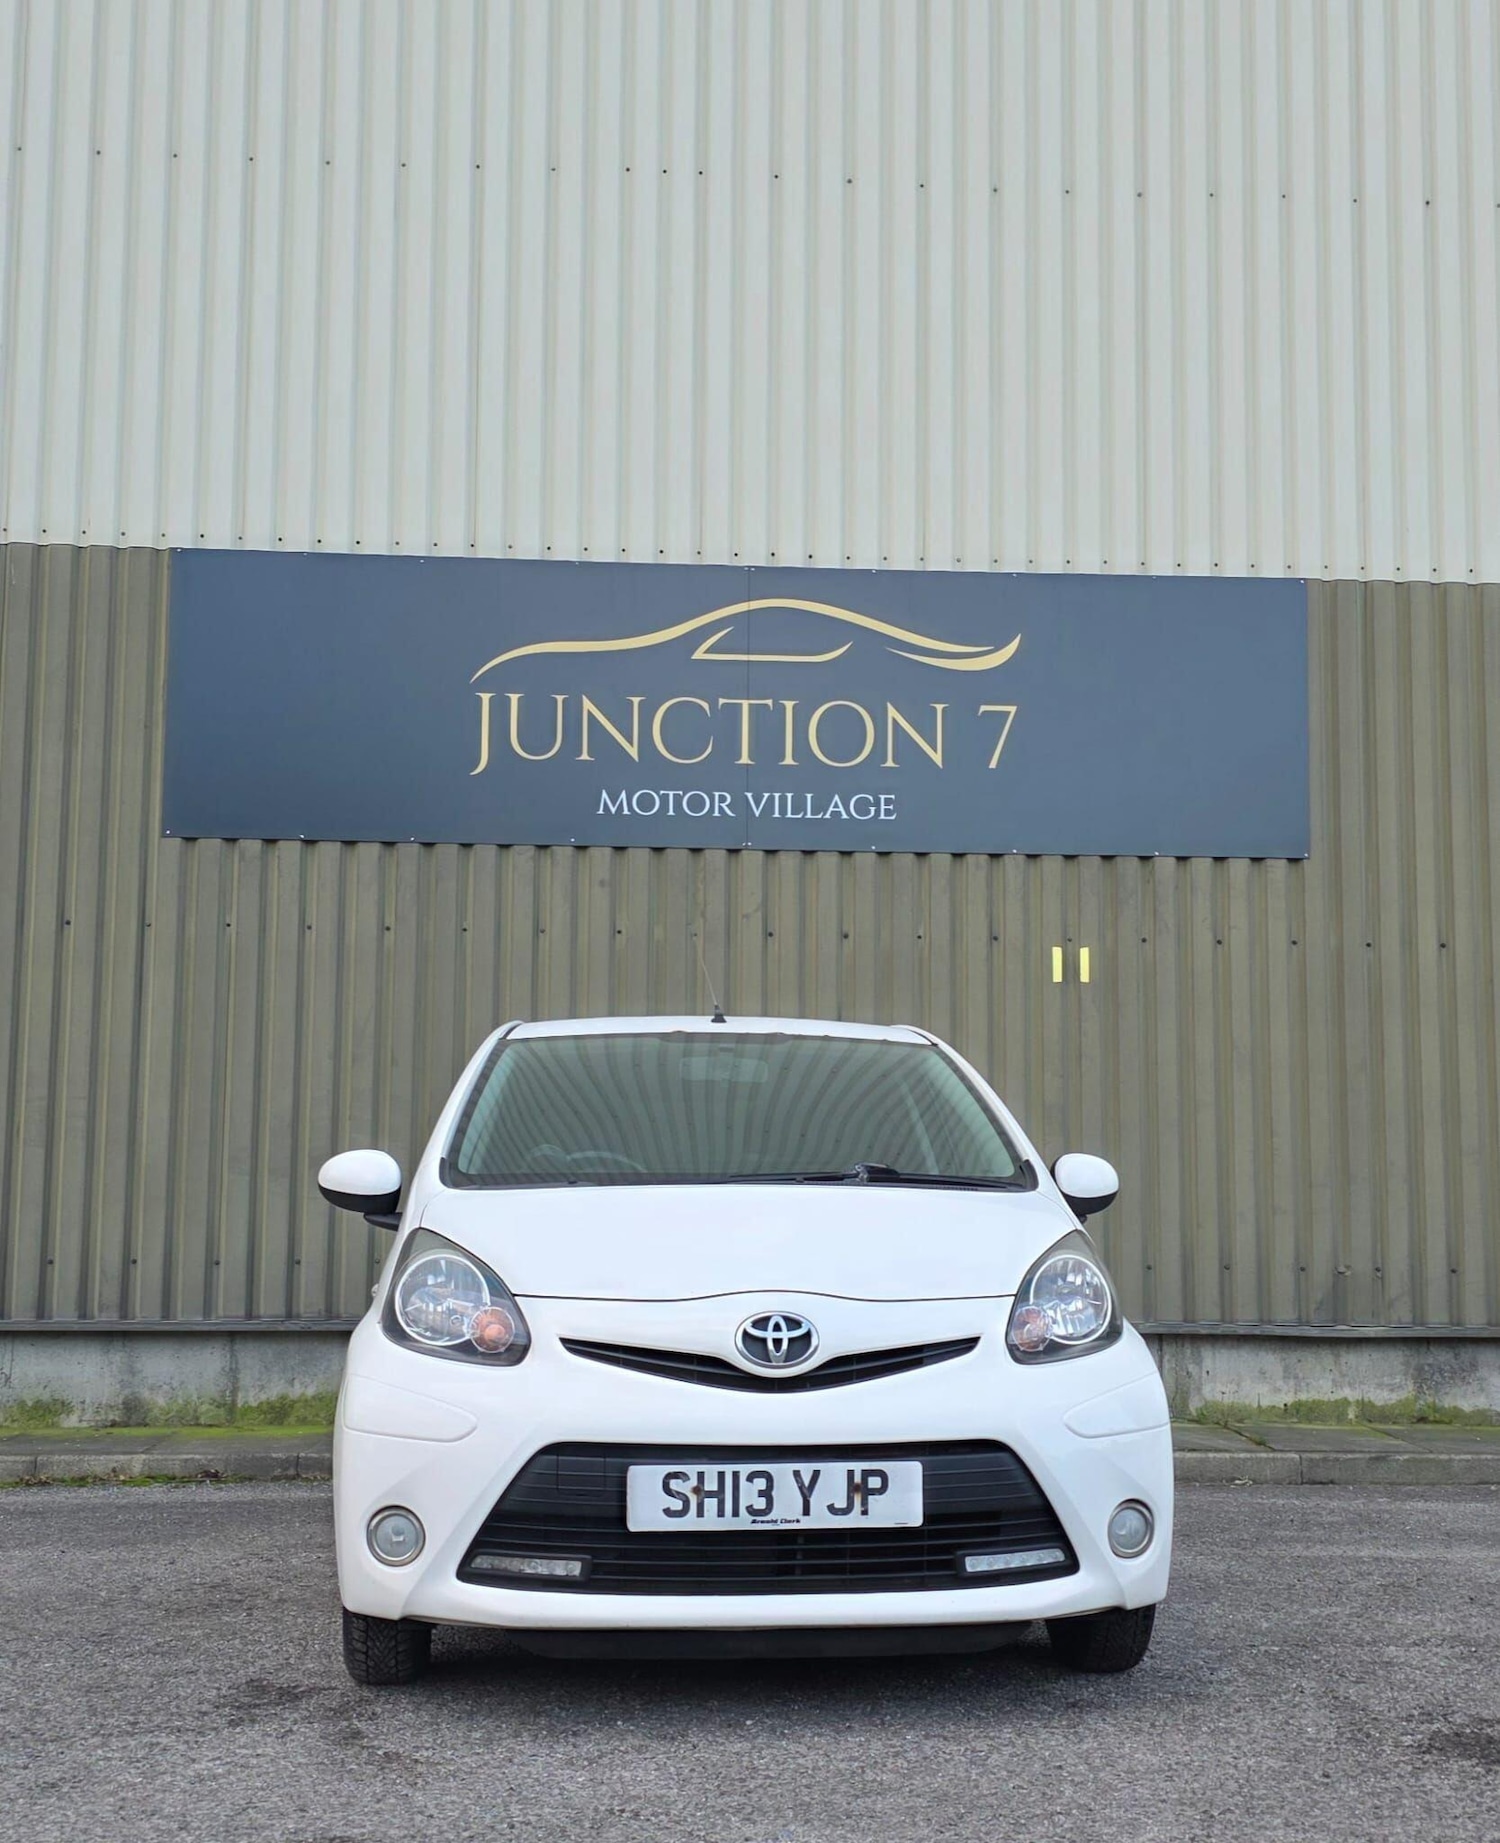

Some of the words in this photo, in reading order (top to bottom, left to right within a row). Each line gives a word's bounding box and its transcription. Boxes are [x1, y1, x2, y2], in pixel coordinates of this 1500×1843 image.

[470, 693, 949, 775] JUNCTION
[978, 705, 1018, 769] 7
[596, 789, 736, 816] MOTOR
[744, 792, 897, 820] VILLAGE
[662, 1470, 775, 1518] SH13
[793, 1469, 889, 1517] YJP
